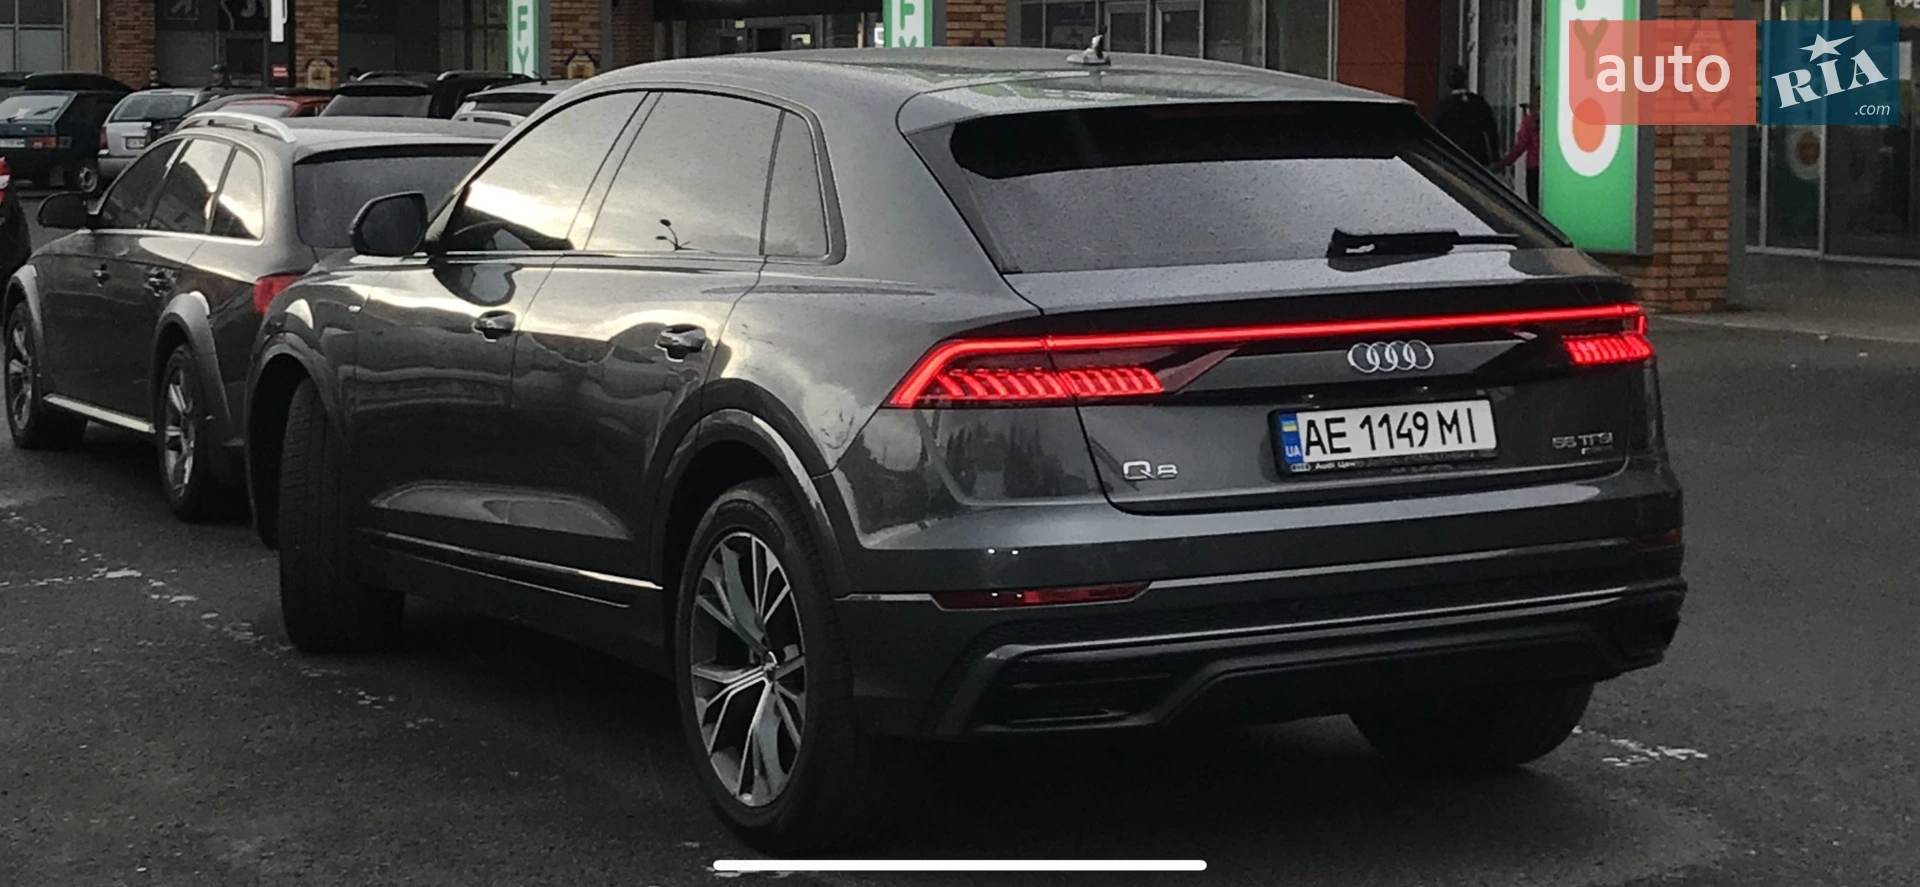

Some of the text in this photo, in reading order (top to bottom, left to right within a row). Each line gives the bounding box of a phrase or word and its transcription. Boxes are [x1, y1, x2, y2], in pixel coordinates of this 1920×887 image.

[1305, 407, 1477, 457] AE 1149 MI
[1284, 445, 1302, 458] UA
[1123, 460, 1178, 480] Q8
